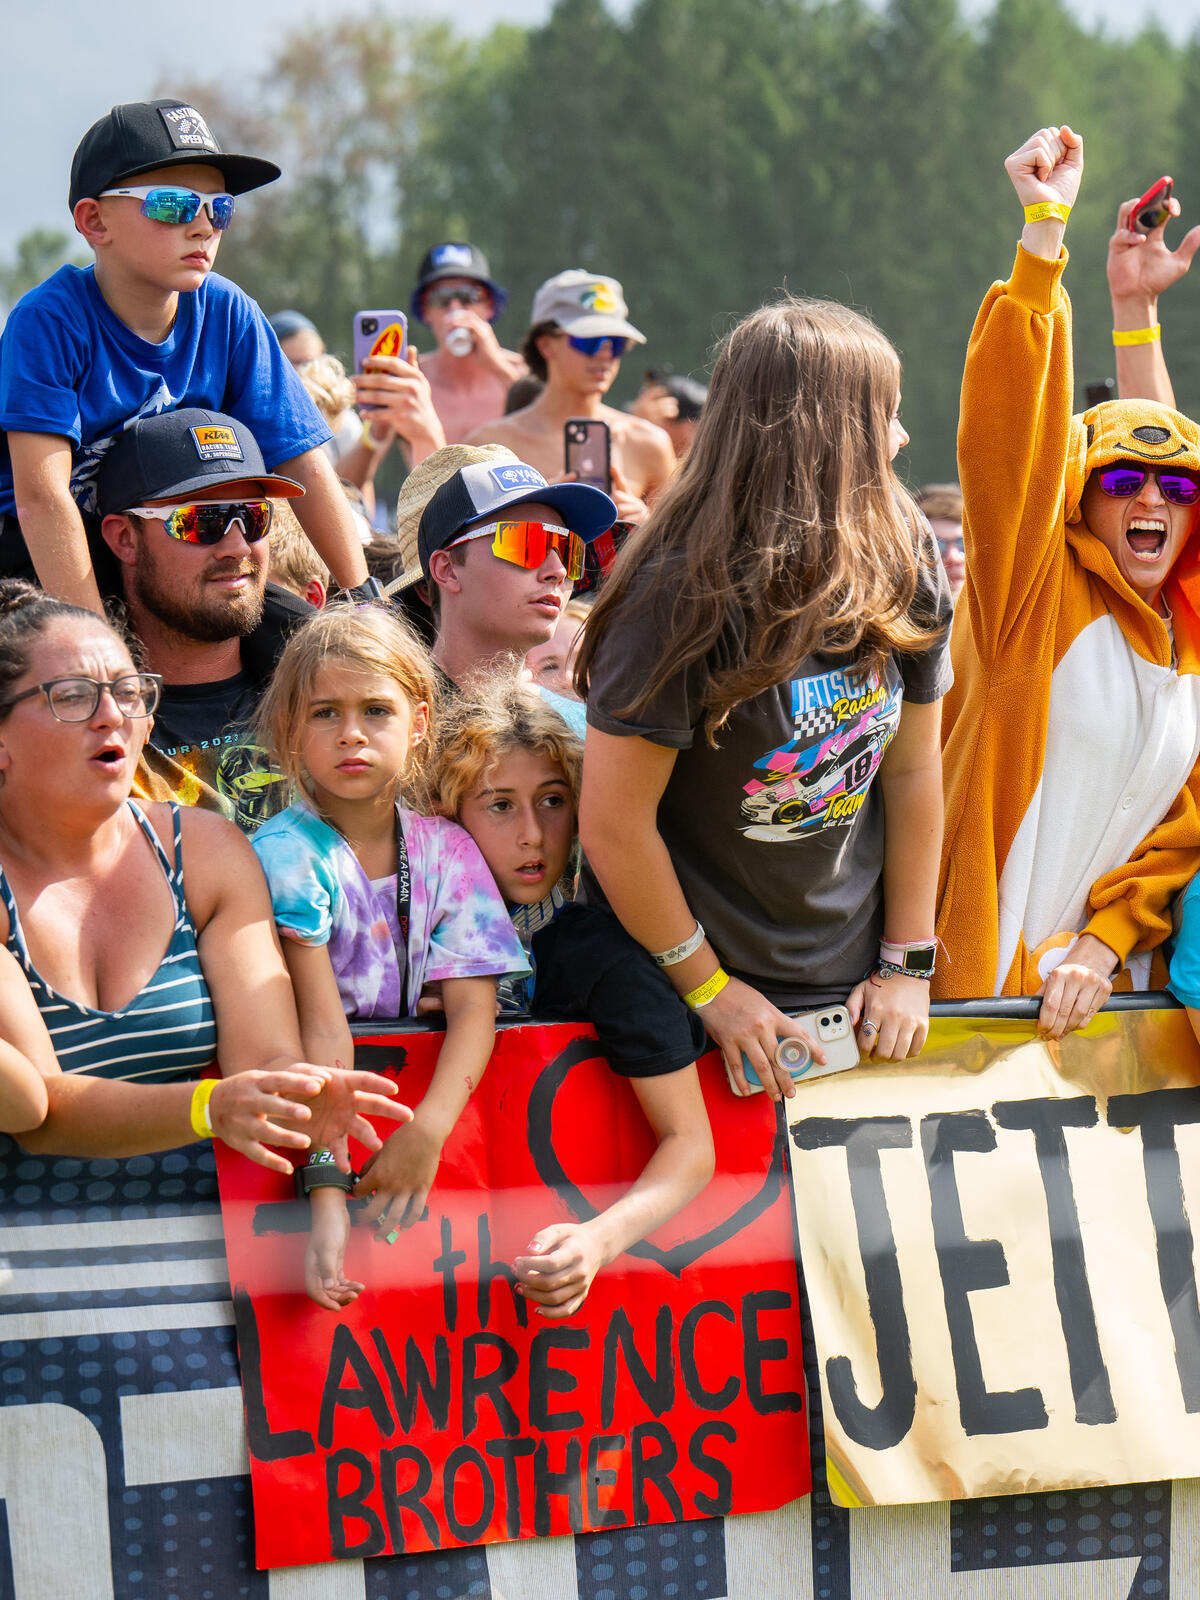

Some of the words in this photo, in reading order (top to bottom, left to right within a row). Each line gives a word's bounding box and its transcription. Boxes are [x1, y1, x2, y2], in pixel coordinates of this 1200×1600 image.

[205, 431, 229, 440] KTM
[832, 686, 887, 726] Racing
[843, 751, 873, 790] 18
[432, 1211, 590, 1332] th
[233, 1286, 803, 1463] LAWRENCE
[325, 1421, 738, 1560] BROTHERS
